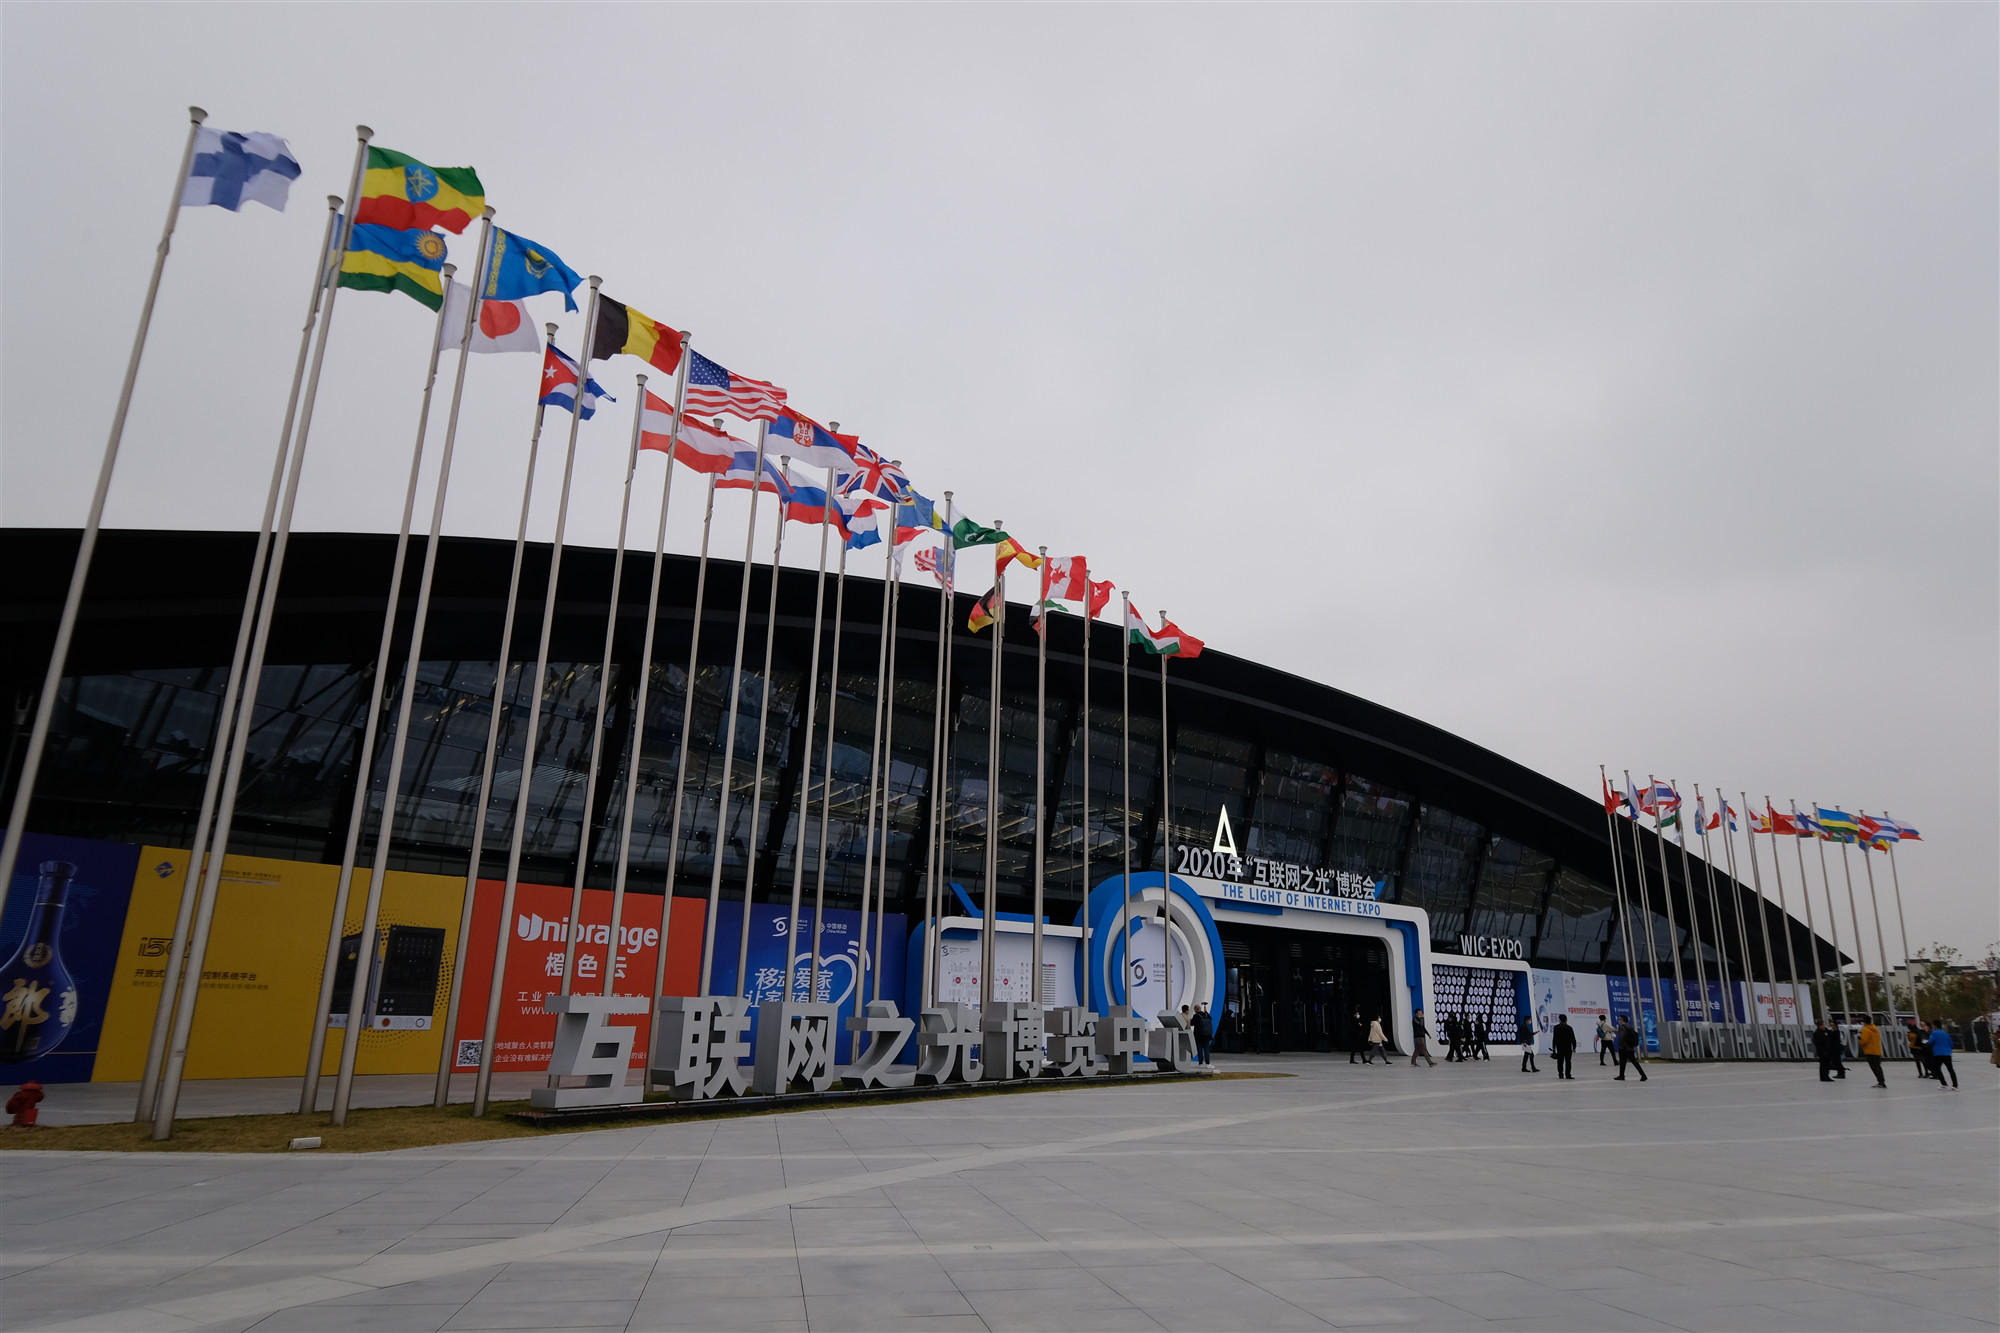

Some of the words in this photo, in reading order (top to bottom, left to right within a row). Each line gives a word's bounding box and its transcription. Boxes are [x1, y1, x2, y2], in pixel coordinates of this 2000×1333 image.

[1222, 884, 1244, 899] THE
[1249, 888, 1281, 903] LIGHT
[1286, 893, 1299, 905] OF
[1304, 895, 1352, 913] INTERNET
[1357, 903, 1381, 916] EXPO
[1460, 934, 1523, 959] WIC-EXPO
[744, 989, 831, 1008] 让家有爱
[531, 996, 1199, 1109] 互联网之光博览中心
[1667, 1021, 1706, 1059] LIGHT
[1707, 1022, 1726, 1058] OF
[1726, 1023, 1756, 1058] THE
[1755, 1024, 1817, 1059] INTERNE
